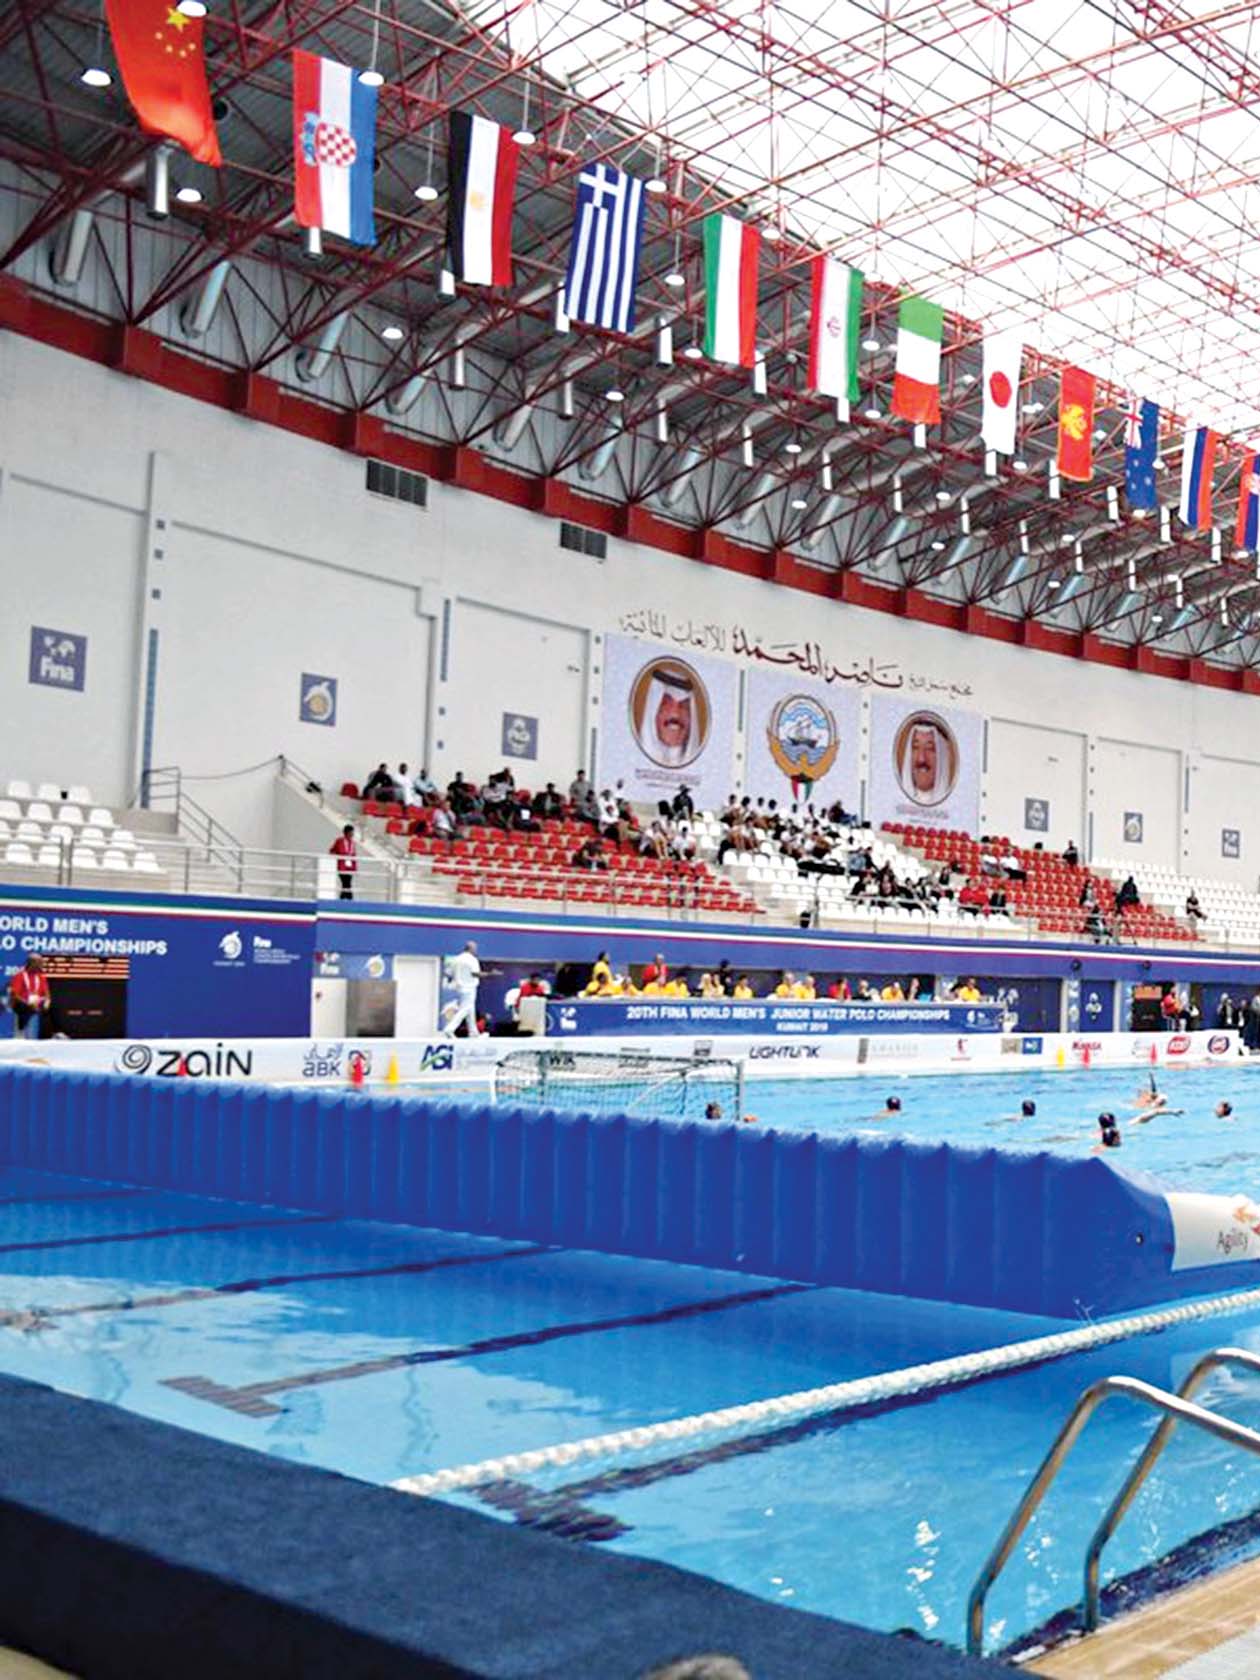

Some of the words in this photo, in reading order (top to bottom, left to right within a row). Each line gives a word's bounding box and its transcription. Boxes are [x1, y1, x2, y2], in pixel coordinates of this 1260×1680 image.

[41, 655, 75, 682] Fina
[0, 916, 48, 932] ORLD
[53, 918, 109, 935] MEN'S
[21, 936, 168, 955] CHAMPIONSHIPS
[626, 1007, 658, 1020] 20TH
[660, 1007, 688, 1019] FINA
[690, 1007, 731, 1020] WORLD
[732, 1007, 766, 1020] MEN'S
[771, 1008, 810, 1020] JUNIOR
[813, 1008, 847, 1021] WATER
[850, 1009, 874, 1021] POLO
[877, 1009, 950, 1021] CHAMPIONSHIPS
